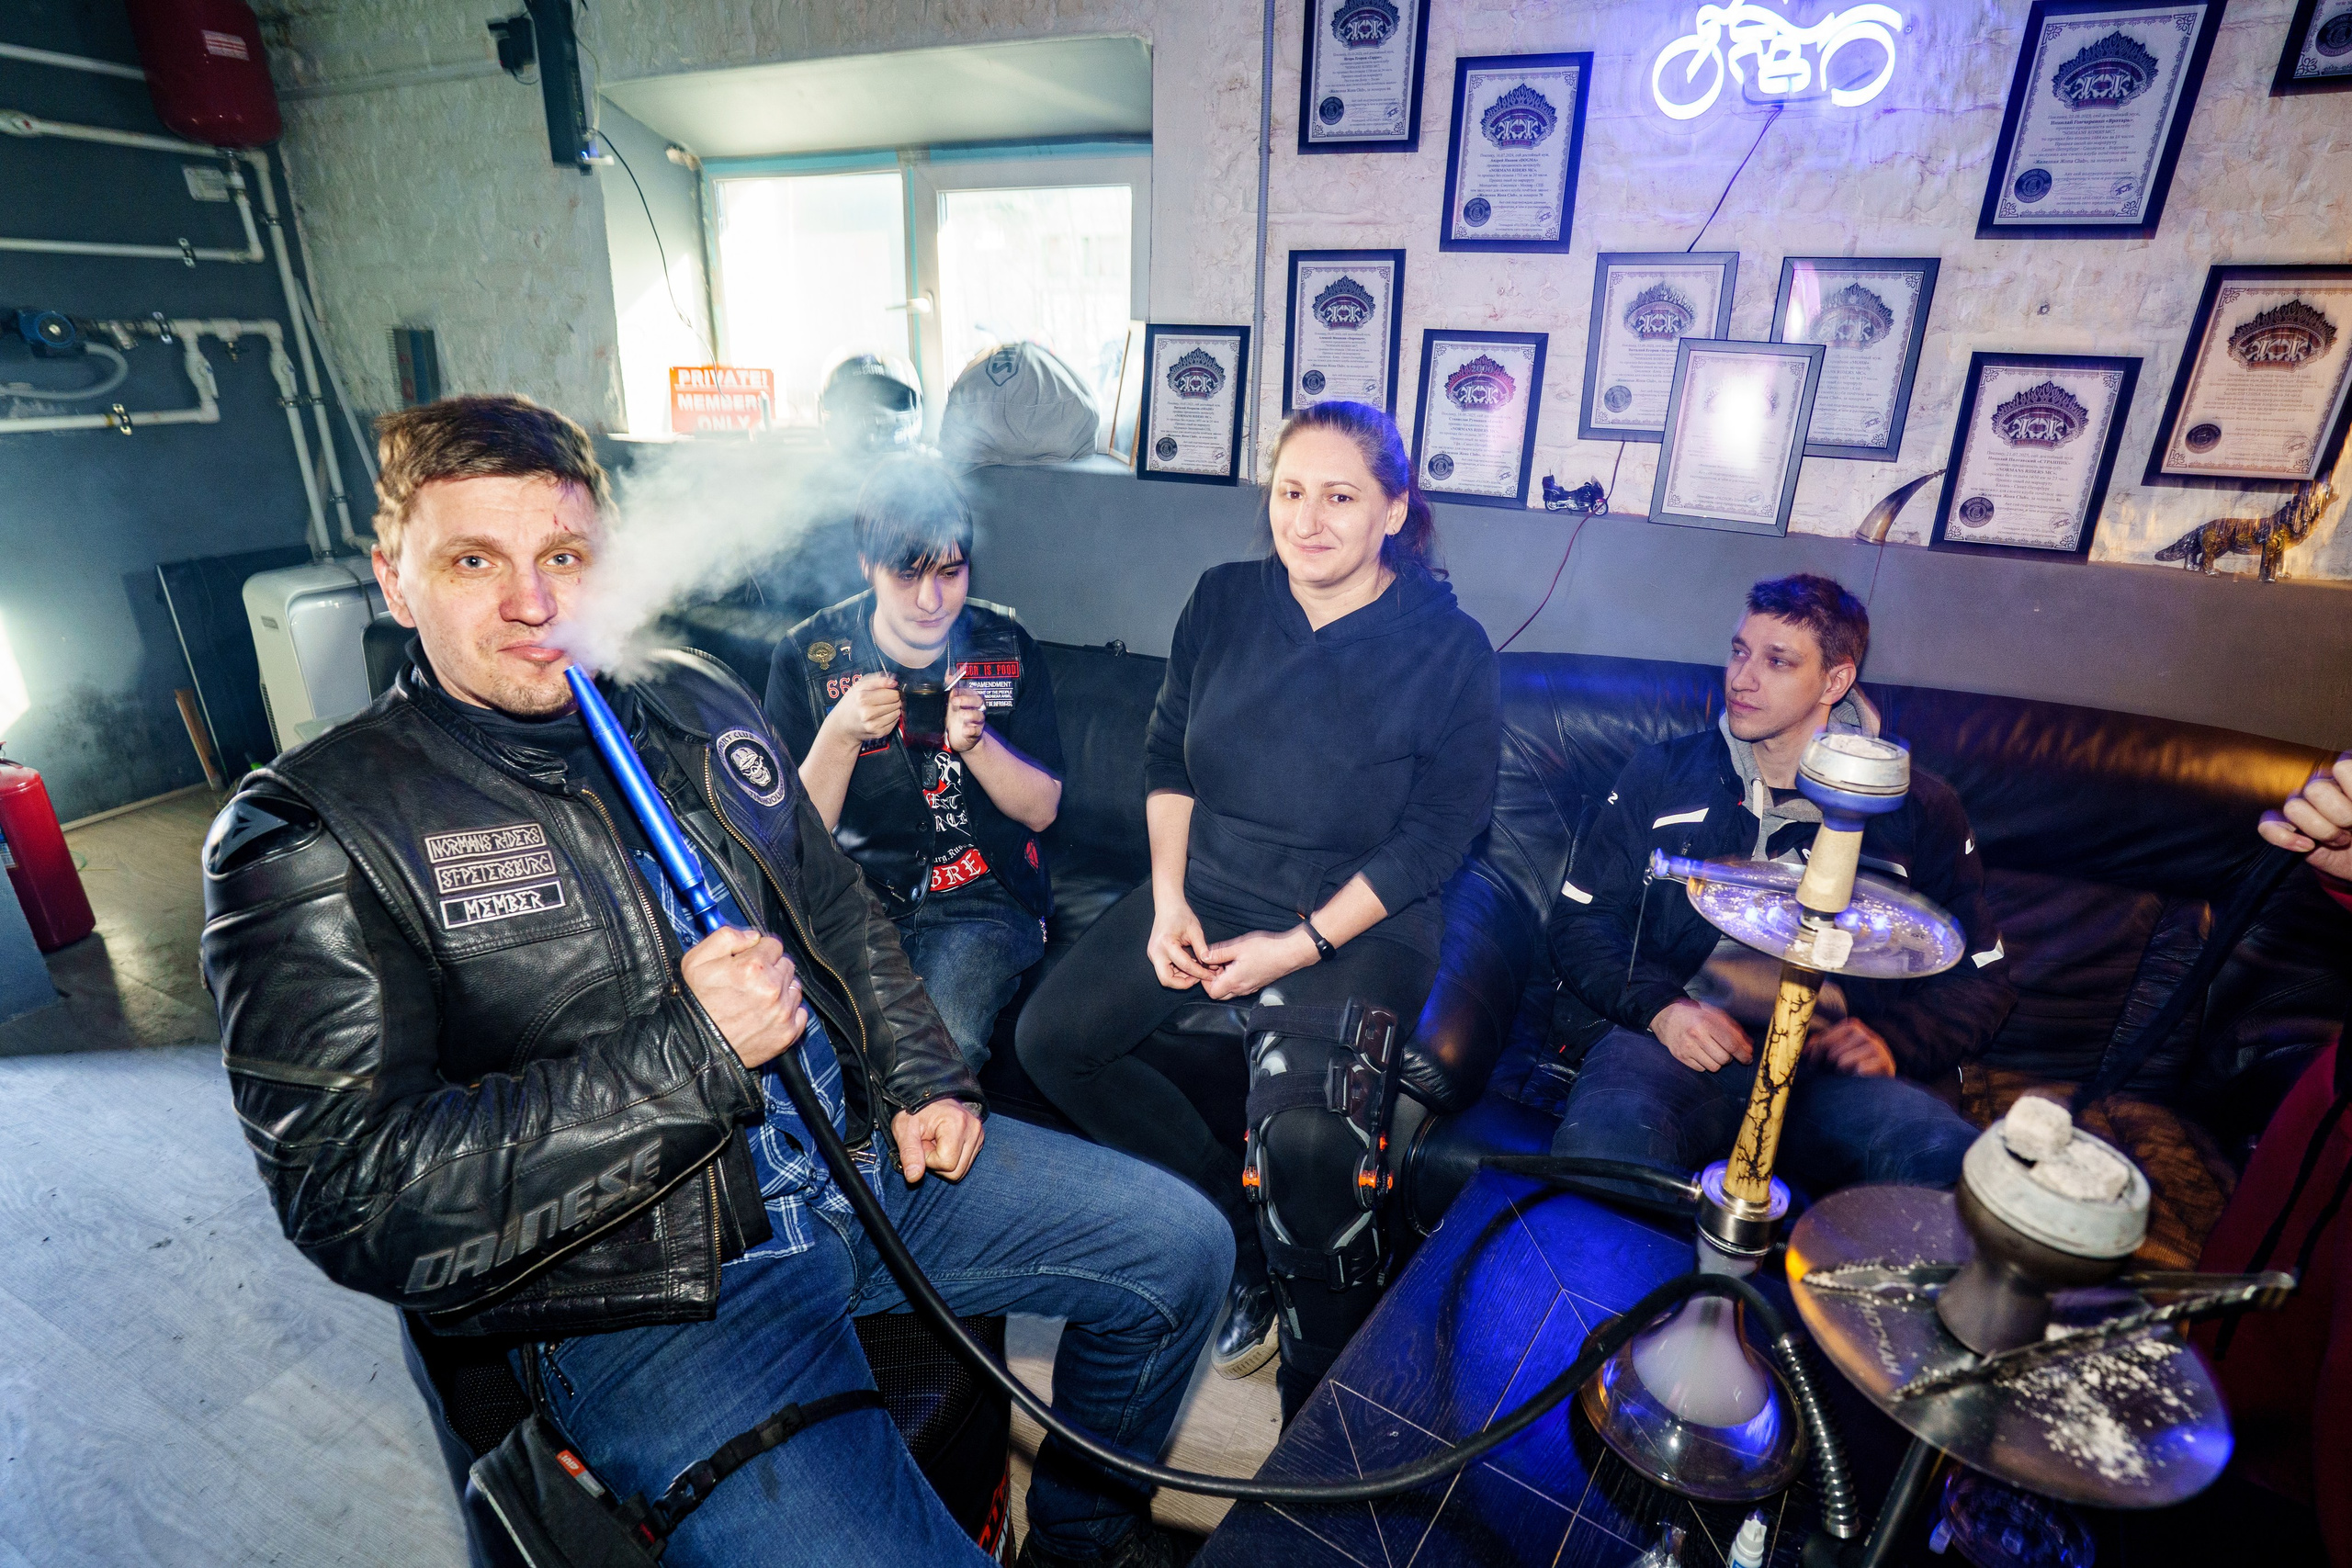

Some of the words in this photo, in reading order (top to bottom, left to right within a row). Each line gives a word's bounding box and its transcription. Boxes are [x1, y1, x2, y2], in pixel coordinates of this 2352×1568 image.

[677, 369, 768, 388] PRIVATE!
[698, 415, 751, 432] ONLY
[983, 665, 991, 675] IS
[997, 664, 1016, 675] FOOD
[430, 833, 492, 858] NORMANS
[492, 828, 540, 850] RIDERS
[463, 890, 545, 921] MEMBER
[404, 1137, 662, 1294] DAINESE
